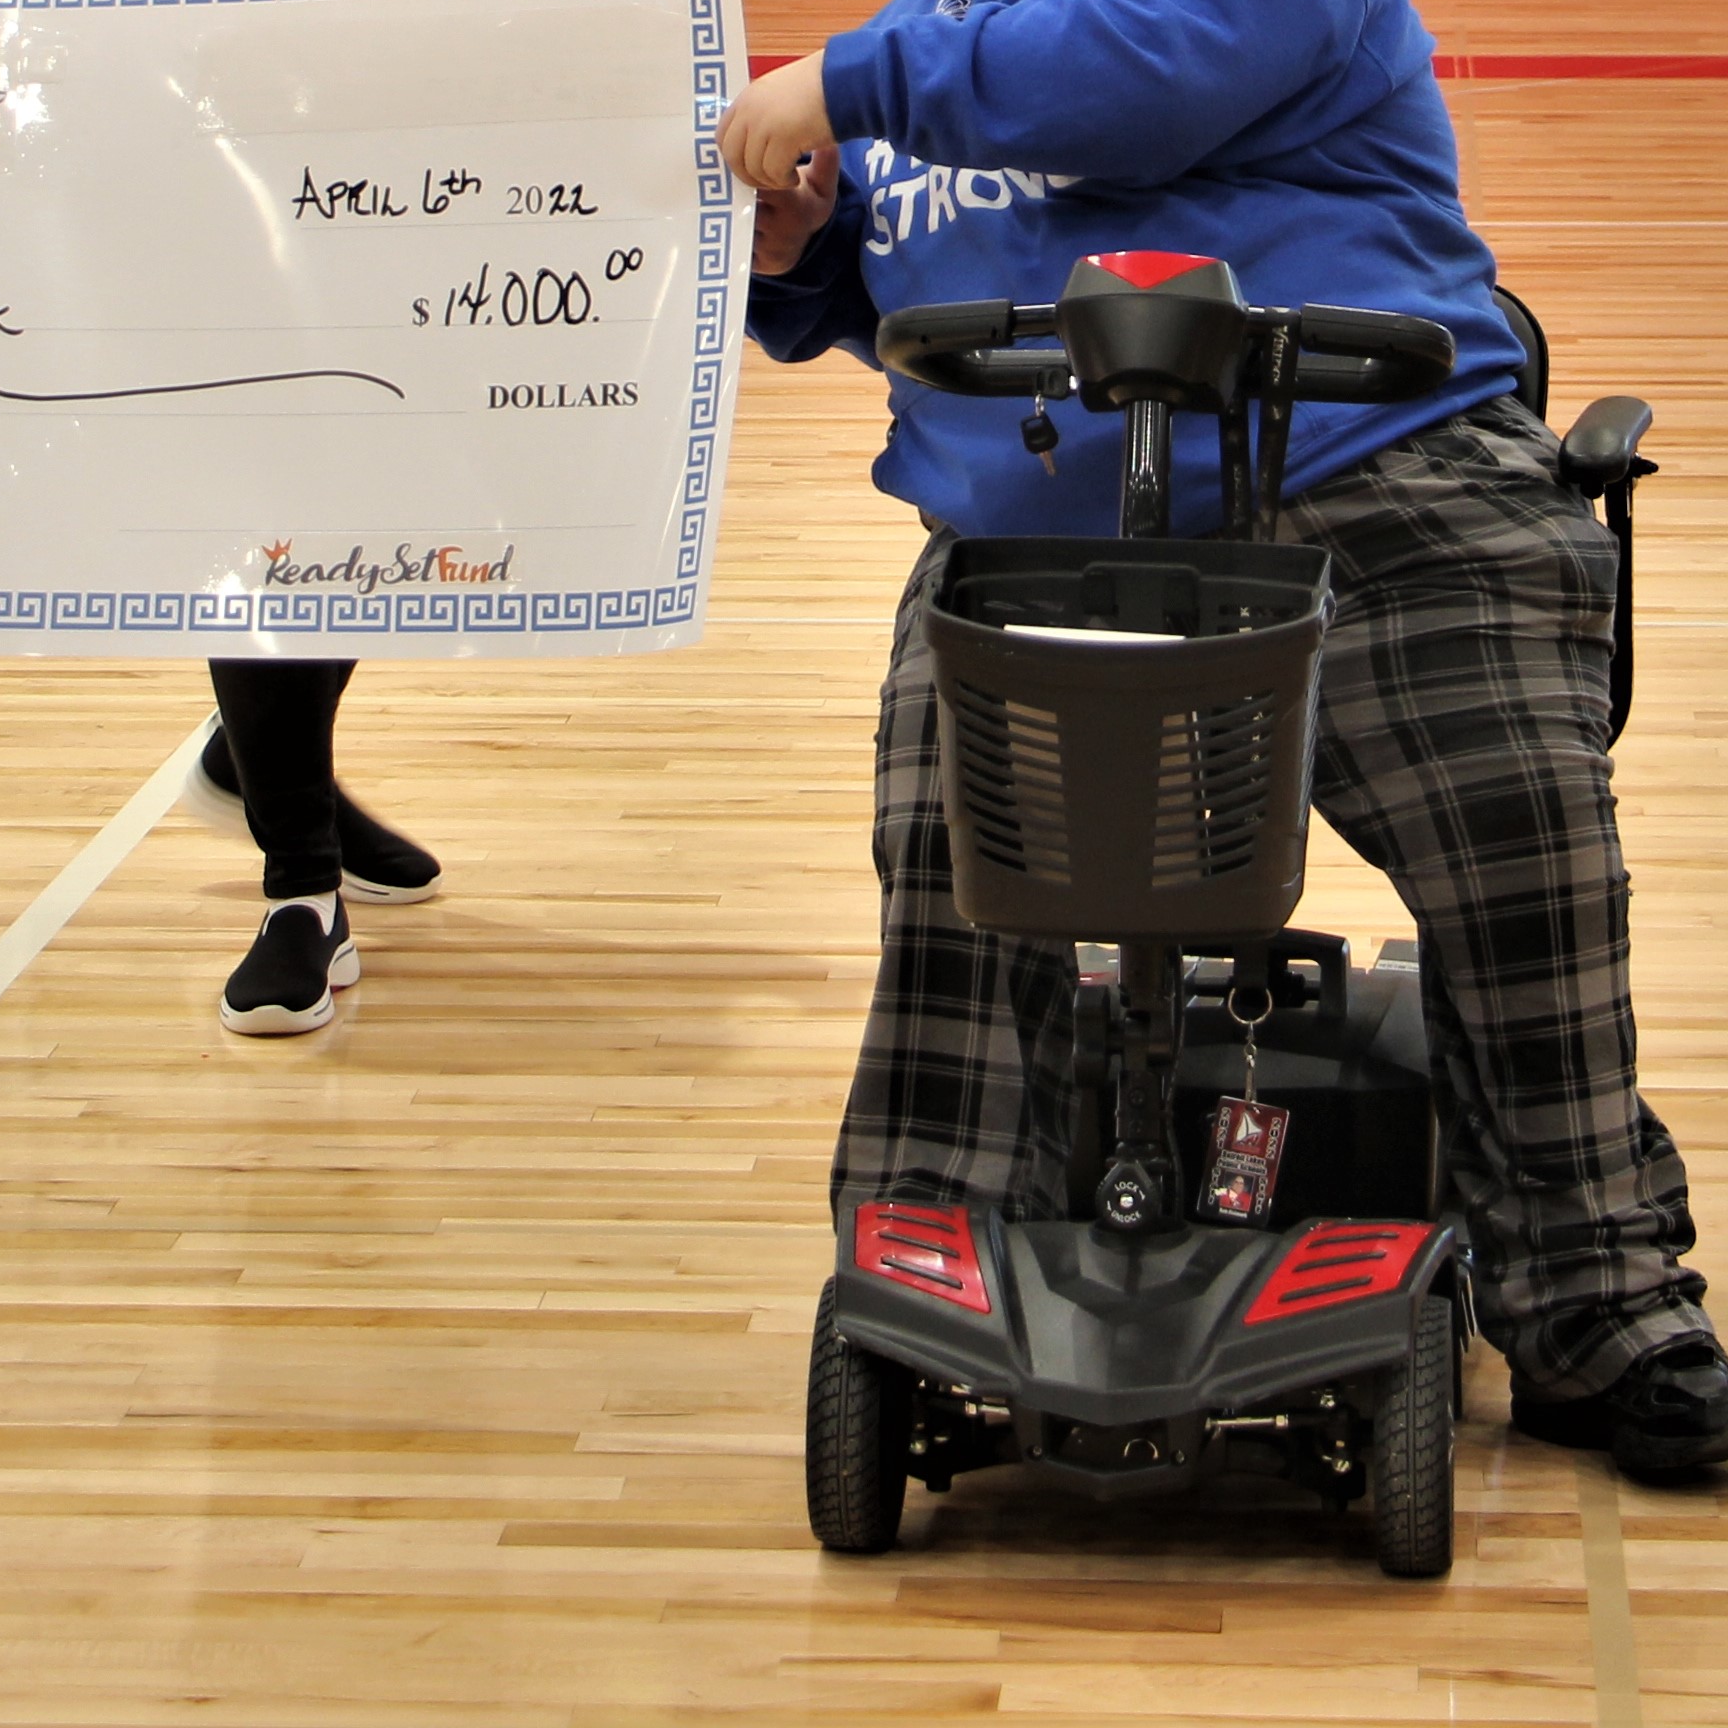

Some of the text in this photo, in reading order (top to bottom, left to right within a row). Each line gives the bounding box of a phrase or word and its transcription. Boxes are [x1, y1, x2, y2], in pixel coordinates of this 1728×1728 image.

[422, 168, 483, 216] 6th
[487, 382, 639, 410] DOLLARS
[1114, 1181, 1139, 1193] LOCK
